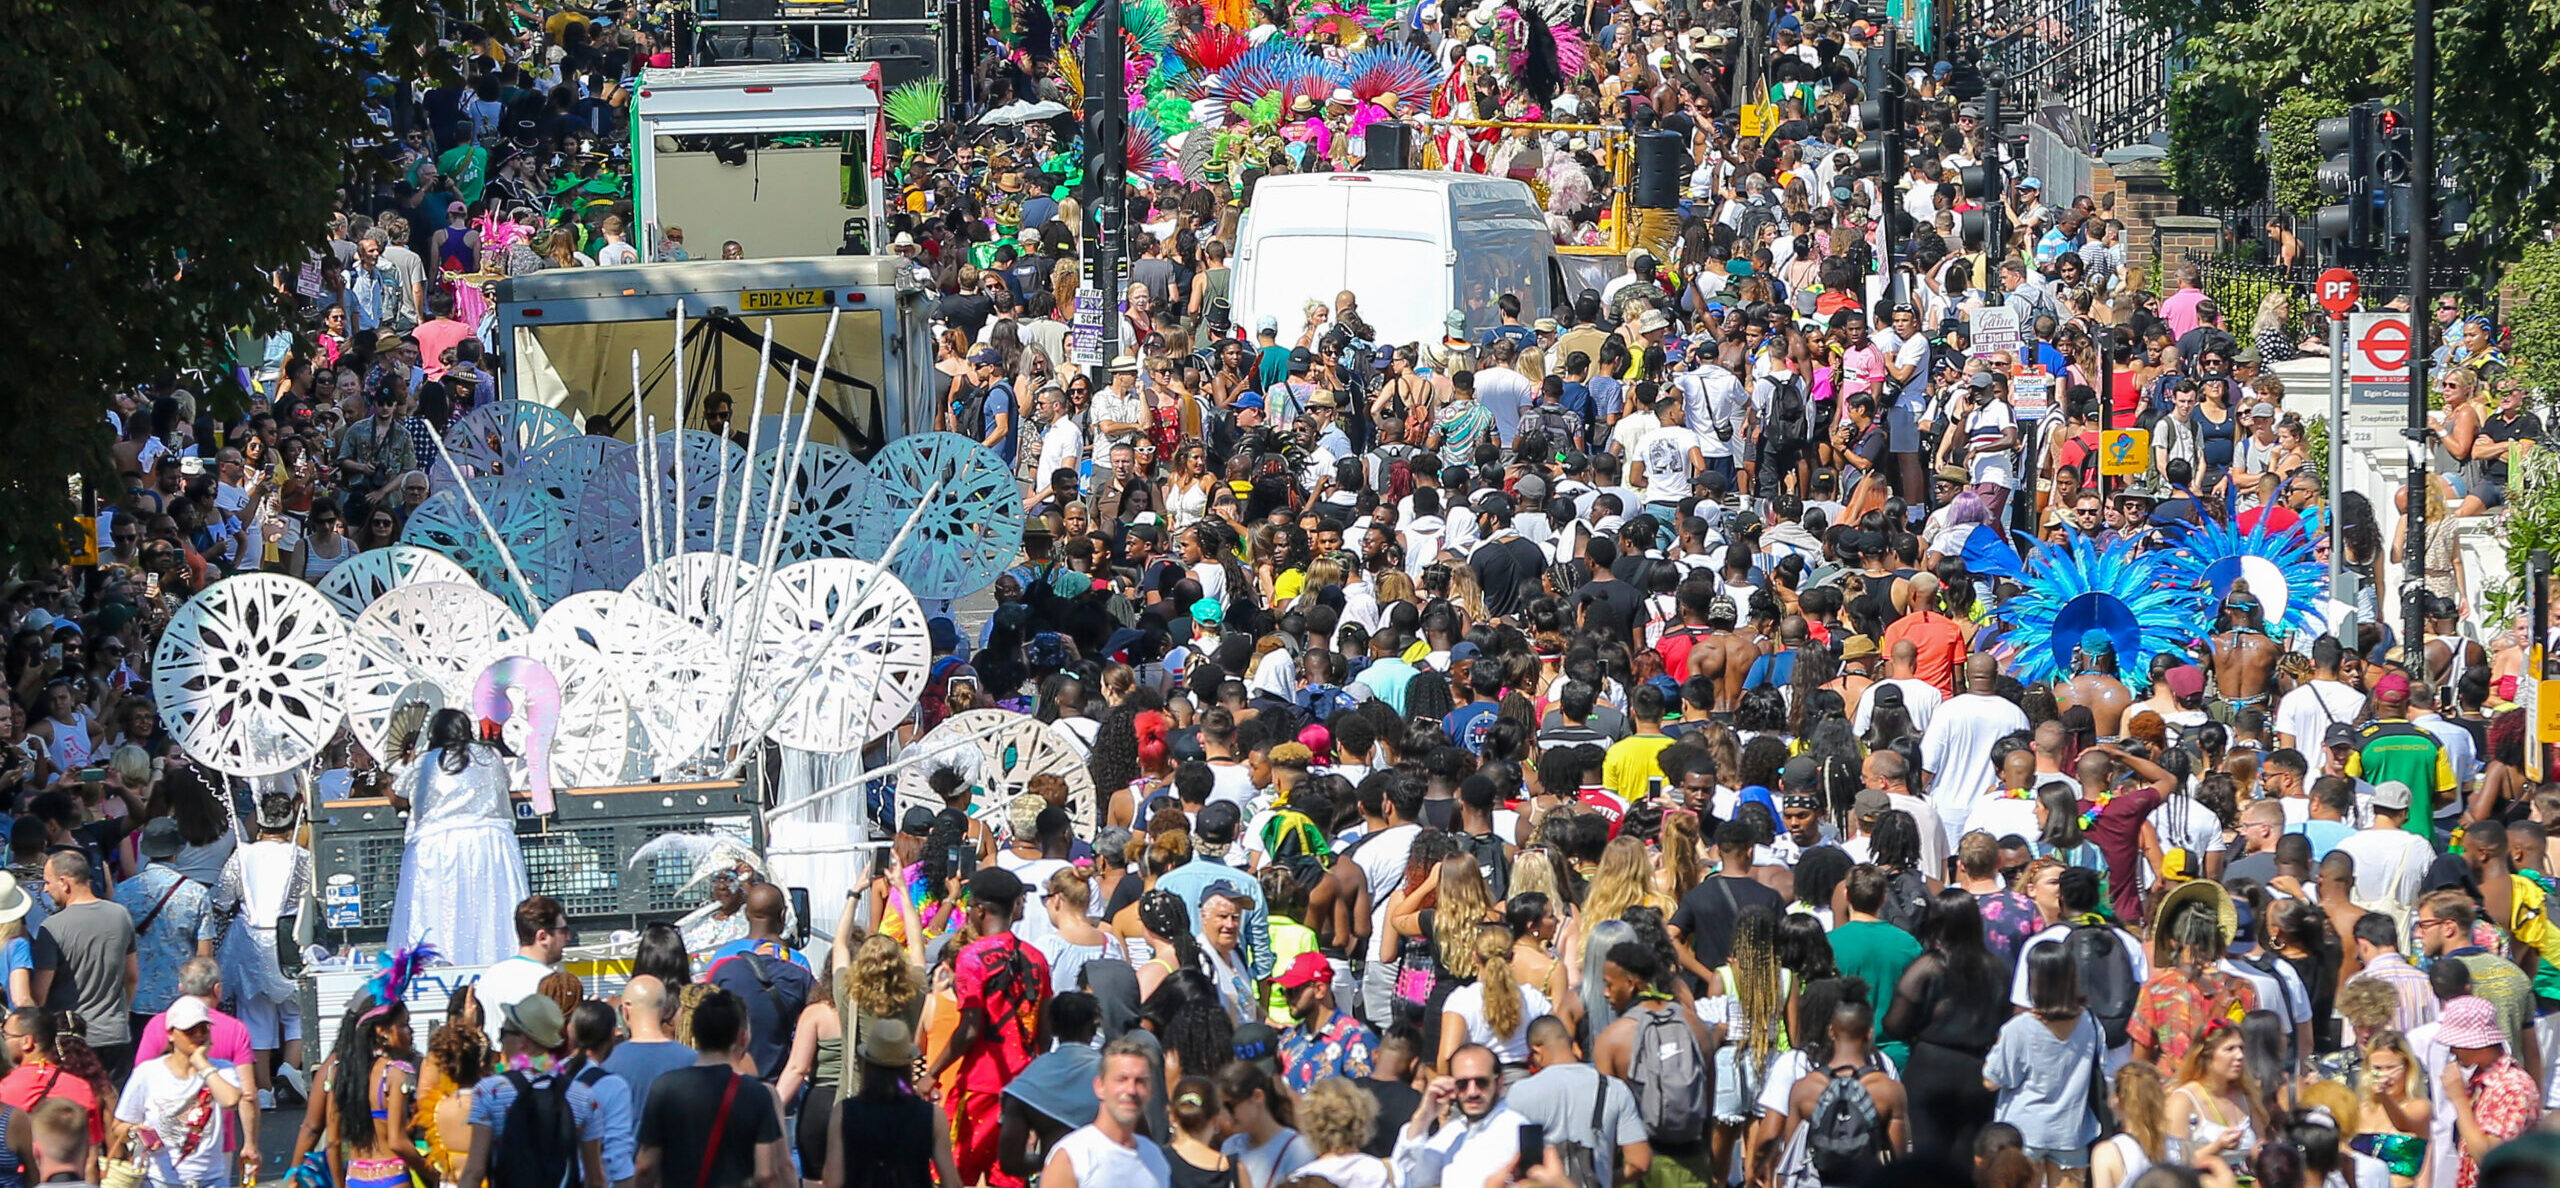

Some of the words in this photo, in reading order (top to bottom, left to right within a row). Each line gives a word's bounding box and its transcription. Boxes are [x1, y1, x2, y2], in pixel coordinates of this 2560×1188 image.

[2324, 281, 2352, 300] PF
[749, 292, 783, 308] FD12
[785, 290, 815, 306] YCZ
[2363, 390, 2382, 399] Elgin
[2382, 390, 2409, 398] Cresce
[2354, 432, 2372, 441] 228
